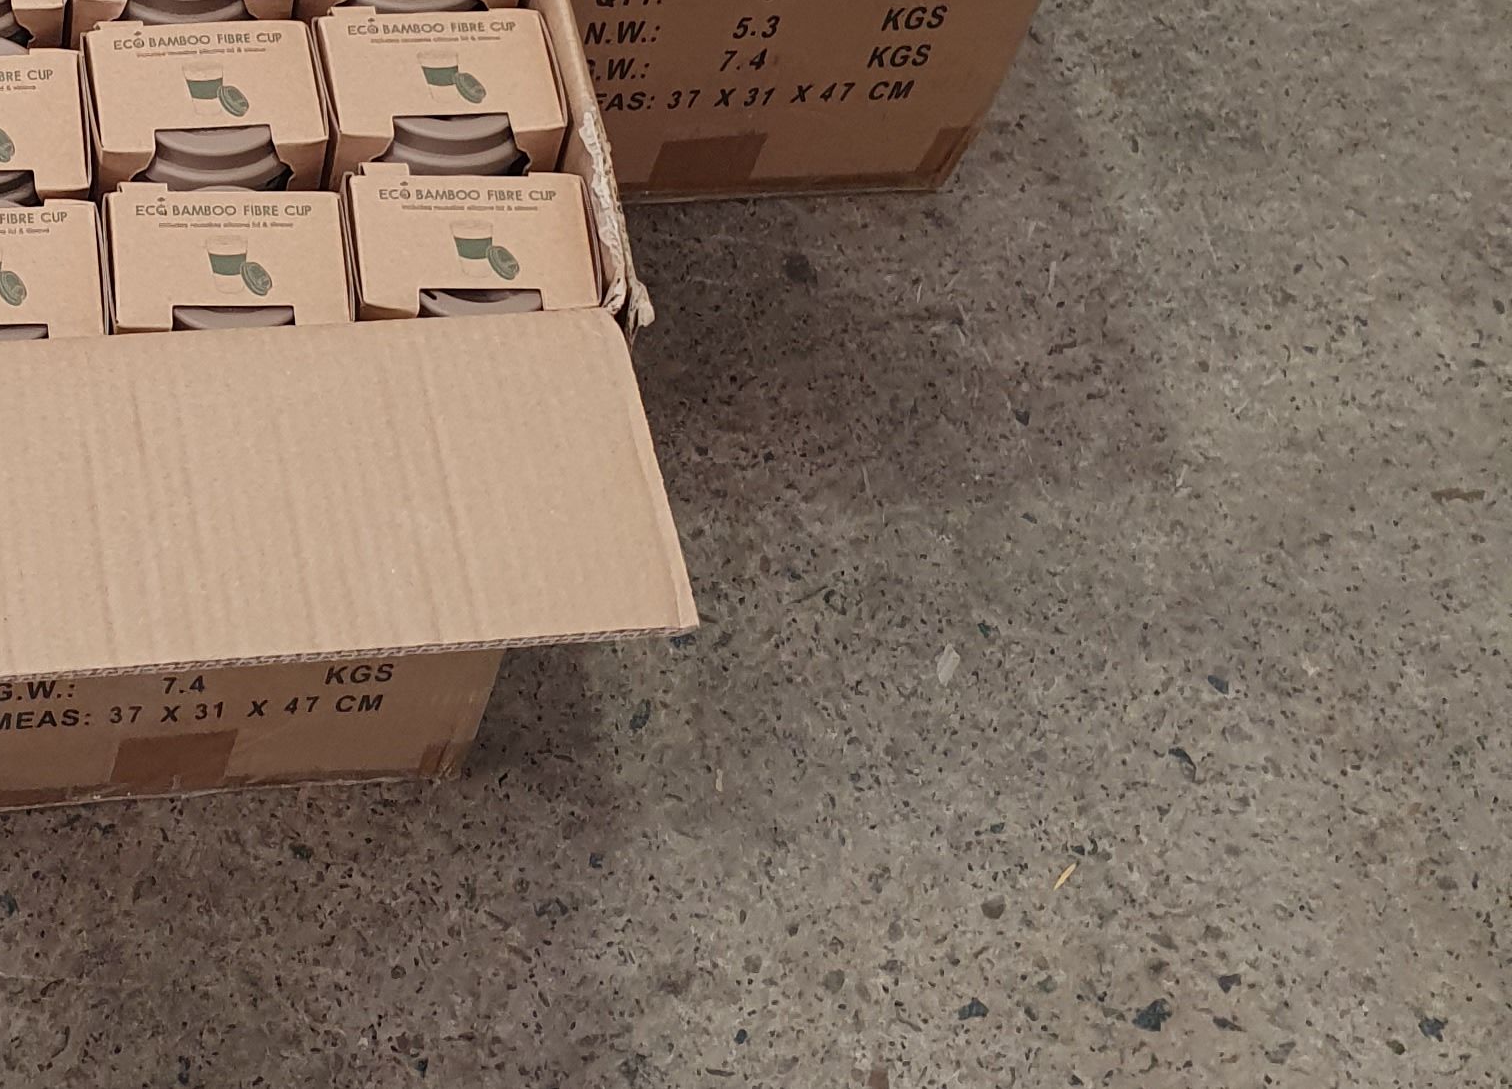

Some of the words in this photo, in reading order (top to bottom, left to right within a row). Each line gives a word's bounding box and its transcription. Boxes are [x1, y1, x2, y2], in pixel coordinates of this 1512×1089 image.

[346, 21, 380, 36] ECO
[381, 22, 446, 35] BAMBOO
[449, 20, 486, 33] FIBRE
[488, 20, 517, 33] CUP
[584, 20, 660, 45] N.W.:
[732, 14, 780, 39] 5.3
[881, 5, 947, 31] KGS
[112, 34, 146, 51] ECO
[147, 33, 212, 48] BAMBOO
[215, 31, 251, 45] FIBRE
[254, 31, 283, 44] CUP
[719, 48, 768, 72] 7.4
[866, 44, 931, 69] KGS
[25, 68, 54, 81] CUP
[666, 89, 701, 110] 37
[713, 88, 736, 108] X
[743, 87, 776, 107] 31
[790, 84, 814, 103] X
[819, 82, 856, 103] 47
[868, 79, 915, 101] CM
[377, 185, 412, 201] ECO
[414, 188, 481, 201] BAMBOO
[486, 188, 524, 202] FIBRE
[527, 189, 557, 202] CUP
[39, 210, 69, 224] CUP
[171, 203, 238, 217] BAMBOO
[242, 203, 280, 217] FIBRE
[283, 204, 313, 217] CUP
[162, 675, 205, 695] 7.4
[324, 663, 394, 685] KGS
[109, 705, 143, 725] 37
[160, 705, 181, 723] X
[194, 701, 224, 720] 31
[247, 699, 268, 717] X
[284, 696, 320, 714] 47
[335, 694, 384, 713] CM
